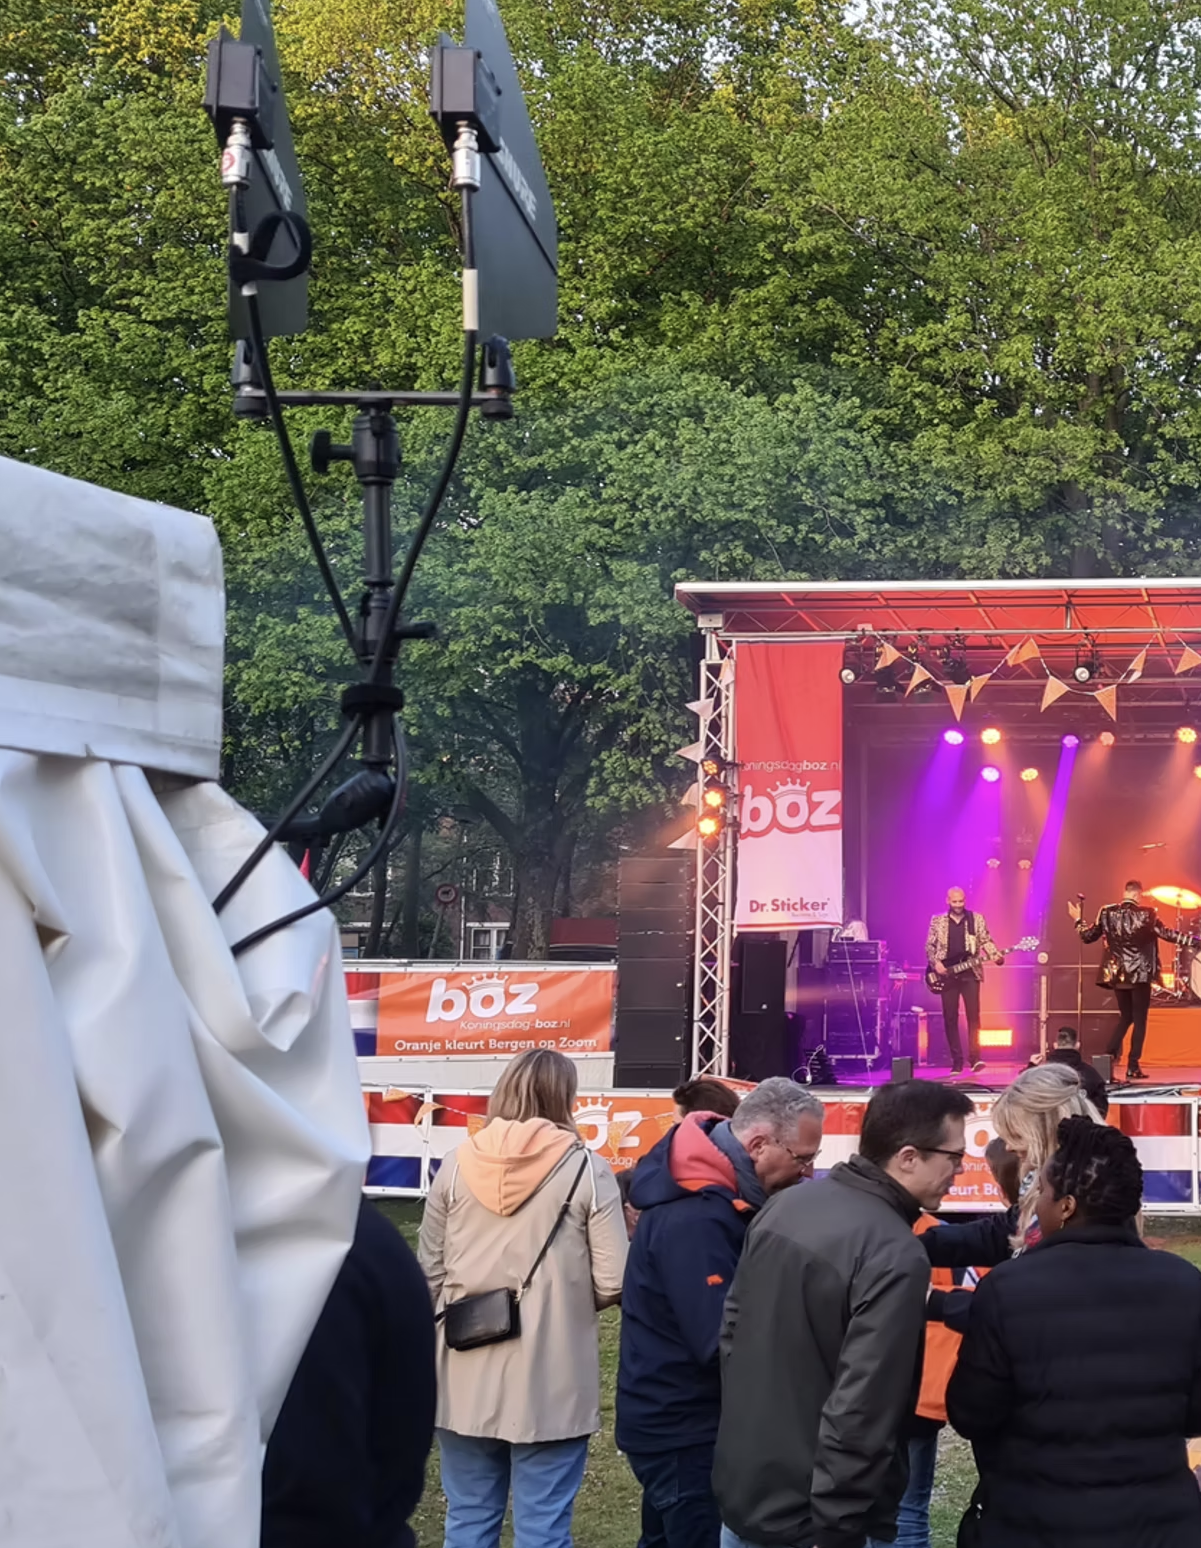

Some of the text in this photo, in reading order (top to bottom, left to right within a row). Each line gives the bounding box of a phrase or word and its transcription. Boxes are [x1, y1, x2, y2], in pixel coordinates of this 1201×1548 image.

[749, 897, 828, 913] Dr. Sticker
[394, 1036, 597, 1053] Oranje kleurt Bergen op Zoom
[948, 1184, 979, 1196] eurt
